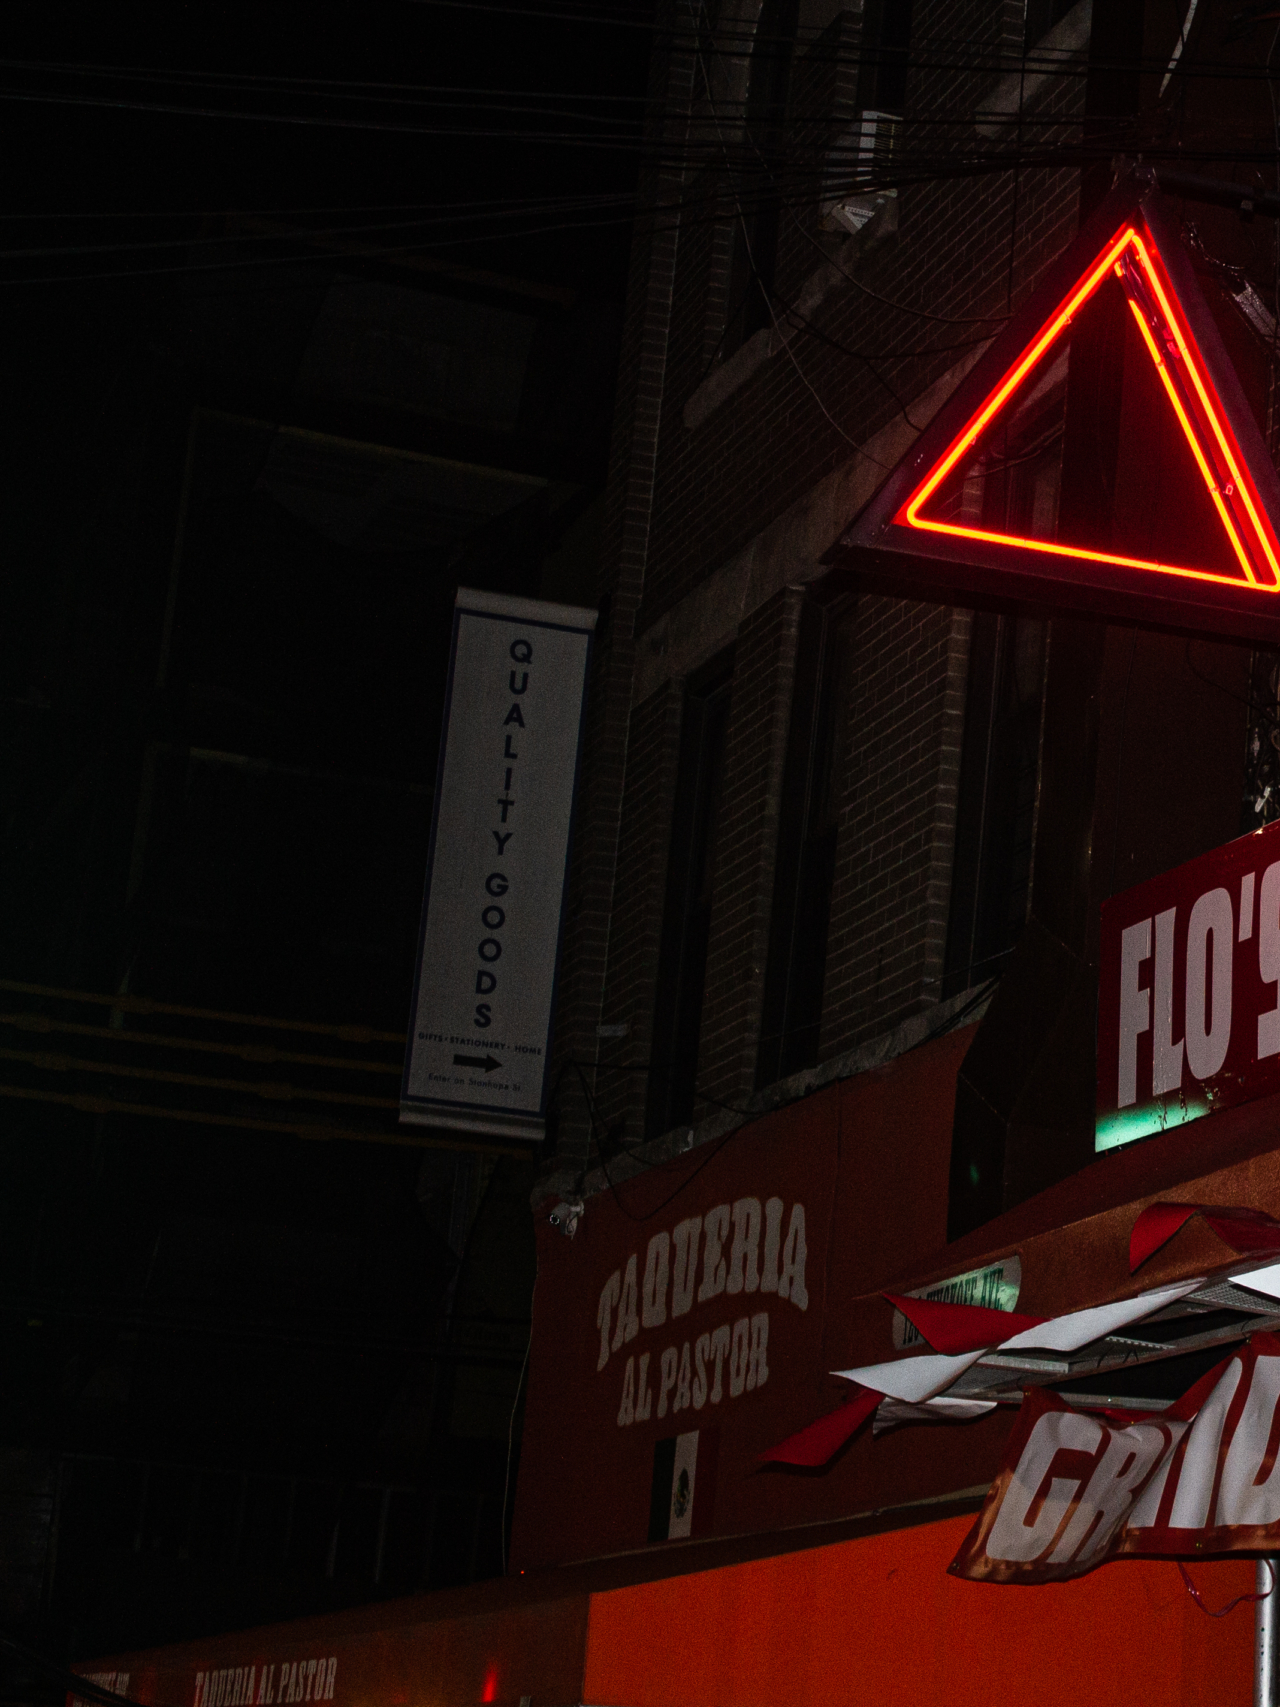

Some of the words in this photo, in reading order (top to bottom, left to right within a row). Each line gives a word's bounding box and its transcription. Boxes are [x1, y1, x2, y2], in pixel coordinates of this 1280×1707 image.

[492, 639, 534, 856] QUALITY
[473, 872, 510, 1029] GOODS
[418, 1032, 443, 1043] GIFTS
[450, 1036, 506, 1050] STATIONERY
[514, 1045, 542, 1056] HOME
[428, 1073, 450, 1083] Enter
[454, 1077, 465, 1086] on
[596, 1196, 809, 1372] TAQUERIA
[616, 1352, 651, 1427] AL
[656, 1311, 769, 1420] PASTOR
[277, 1657, 338, 1703] PASTOR
